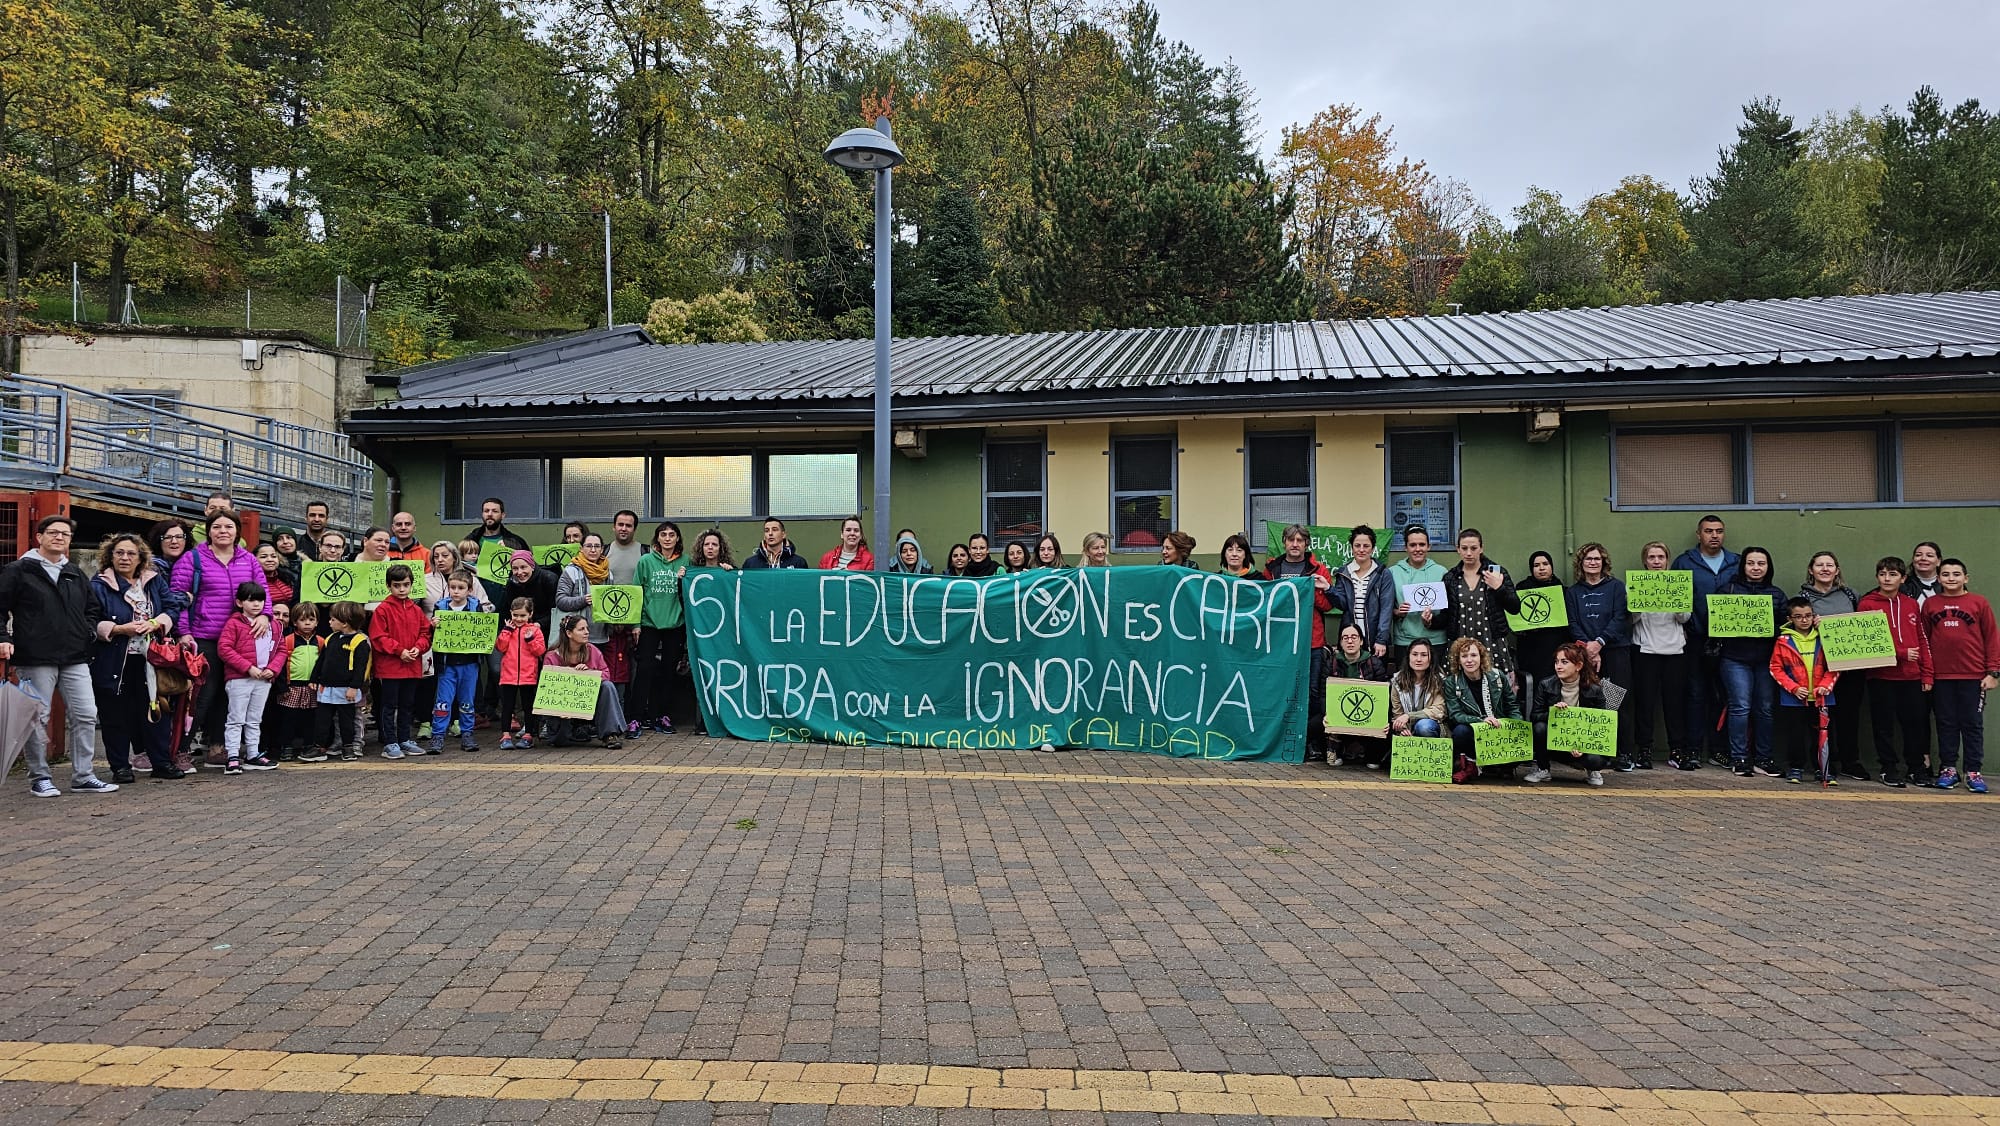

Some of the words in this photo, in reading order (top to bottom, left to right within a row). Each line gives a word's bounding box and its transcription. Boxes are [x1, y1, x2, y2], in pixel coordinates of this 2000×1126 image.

[770, 608, 805, 643] LA
[1125, 602, 1162, 642] ES
[1169, 574, 1299, 654] CARA
[698, 658, 838, 721] PRUEBA
[844, 691, 890, 718] CON
[904, 693, 935, 718] LA
[1029, 724, 1053, 745] DE
